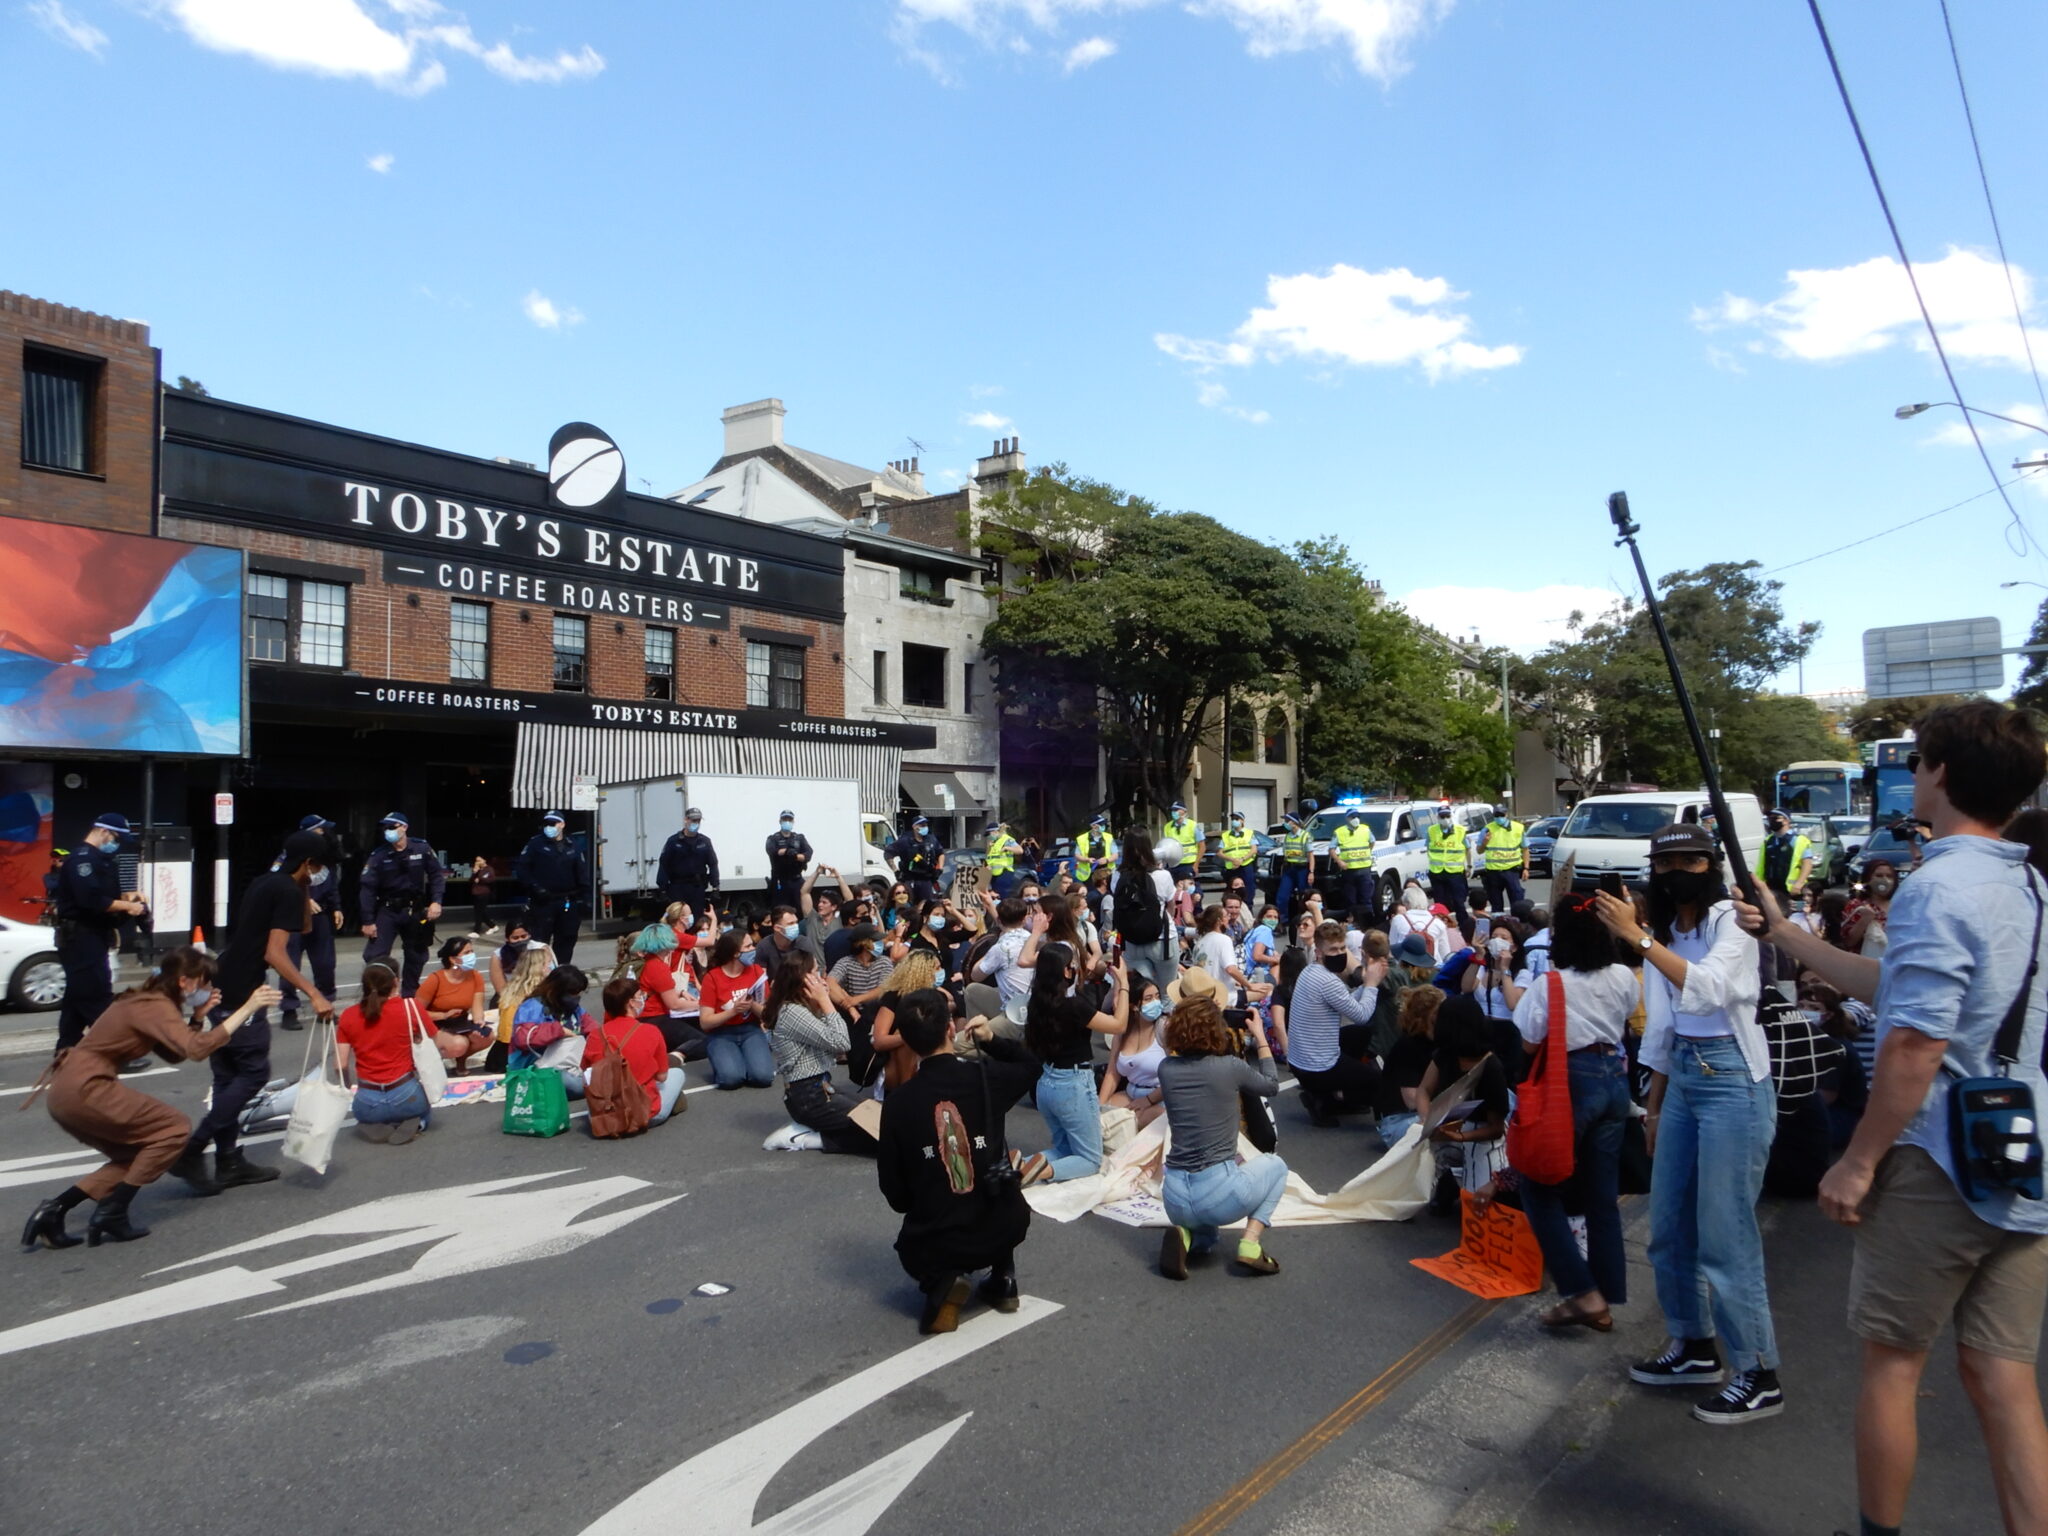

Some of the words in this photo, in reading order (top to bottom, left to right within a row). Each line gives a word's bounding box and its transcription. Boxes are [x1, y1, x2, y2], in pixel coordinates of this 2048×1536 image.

[344, 481, 561, 558] TOBY'S
[584, 528, 759, 593] ESTATE
[438, 563, 547, 602] COFFEE
[562, 583, 693, 623] ROASTERS
[376, 688, 435, 705] COFFEE
[443, 694, 520, 711] ROASTERS
[592, 704, 663, 725] TOBY'S
[669, 710, 738, 729] ESTATE
[790, 721, 826, 734] COFFEE
[830, 724, 877, 738] ROASTERS
[955, 866, 980, 885] FEES
[922, 1145, 935, 1160] 東
[973, 1135, 987, 1149] 京
